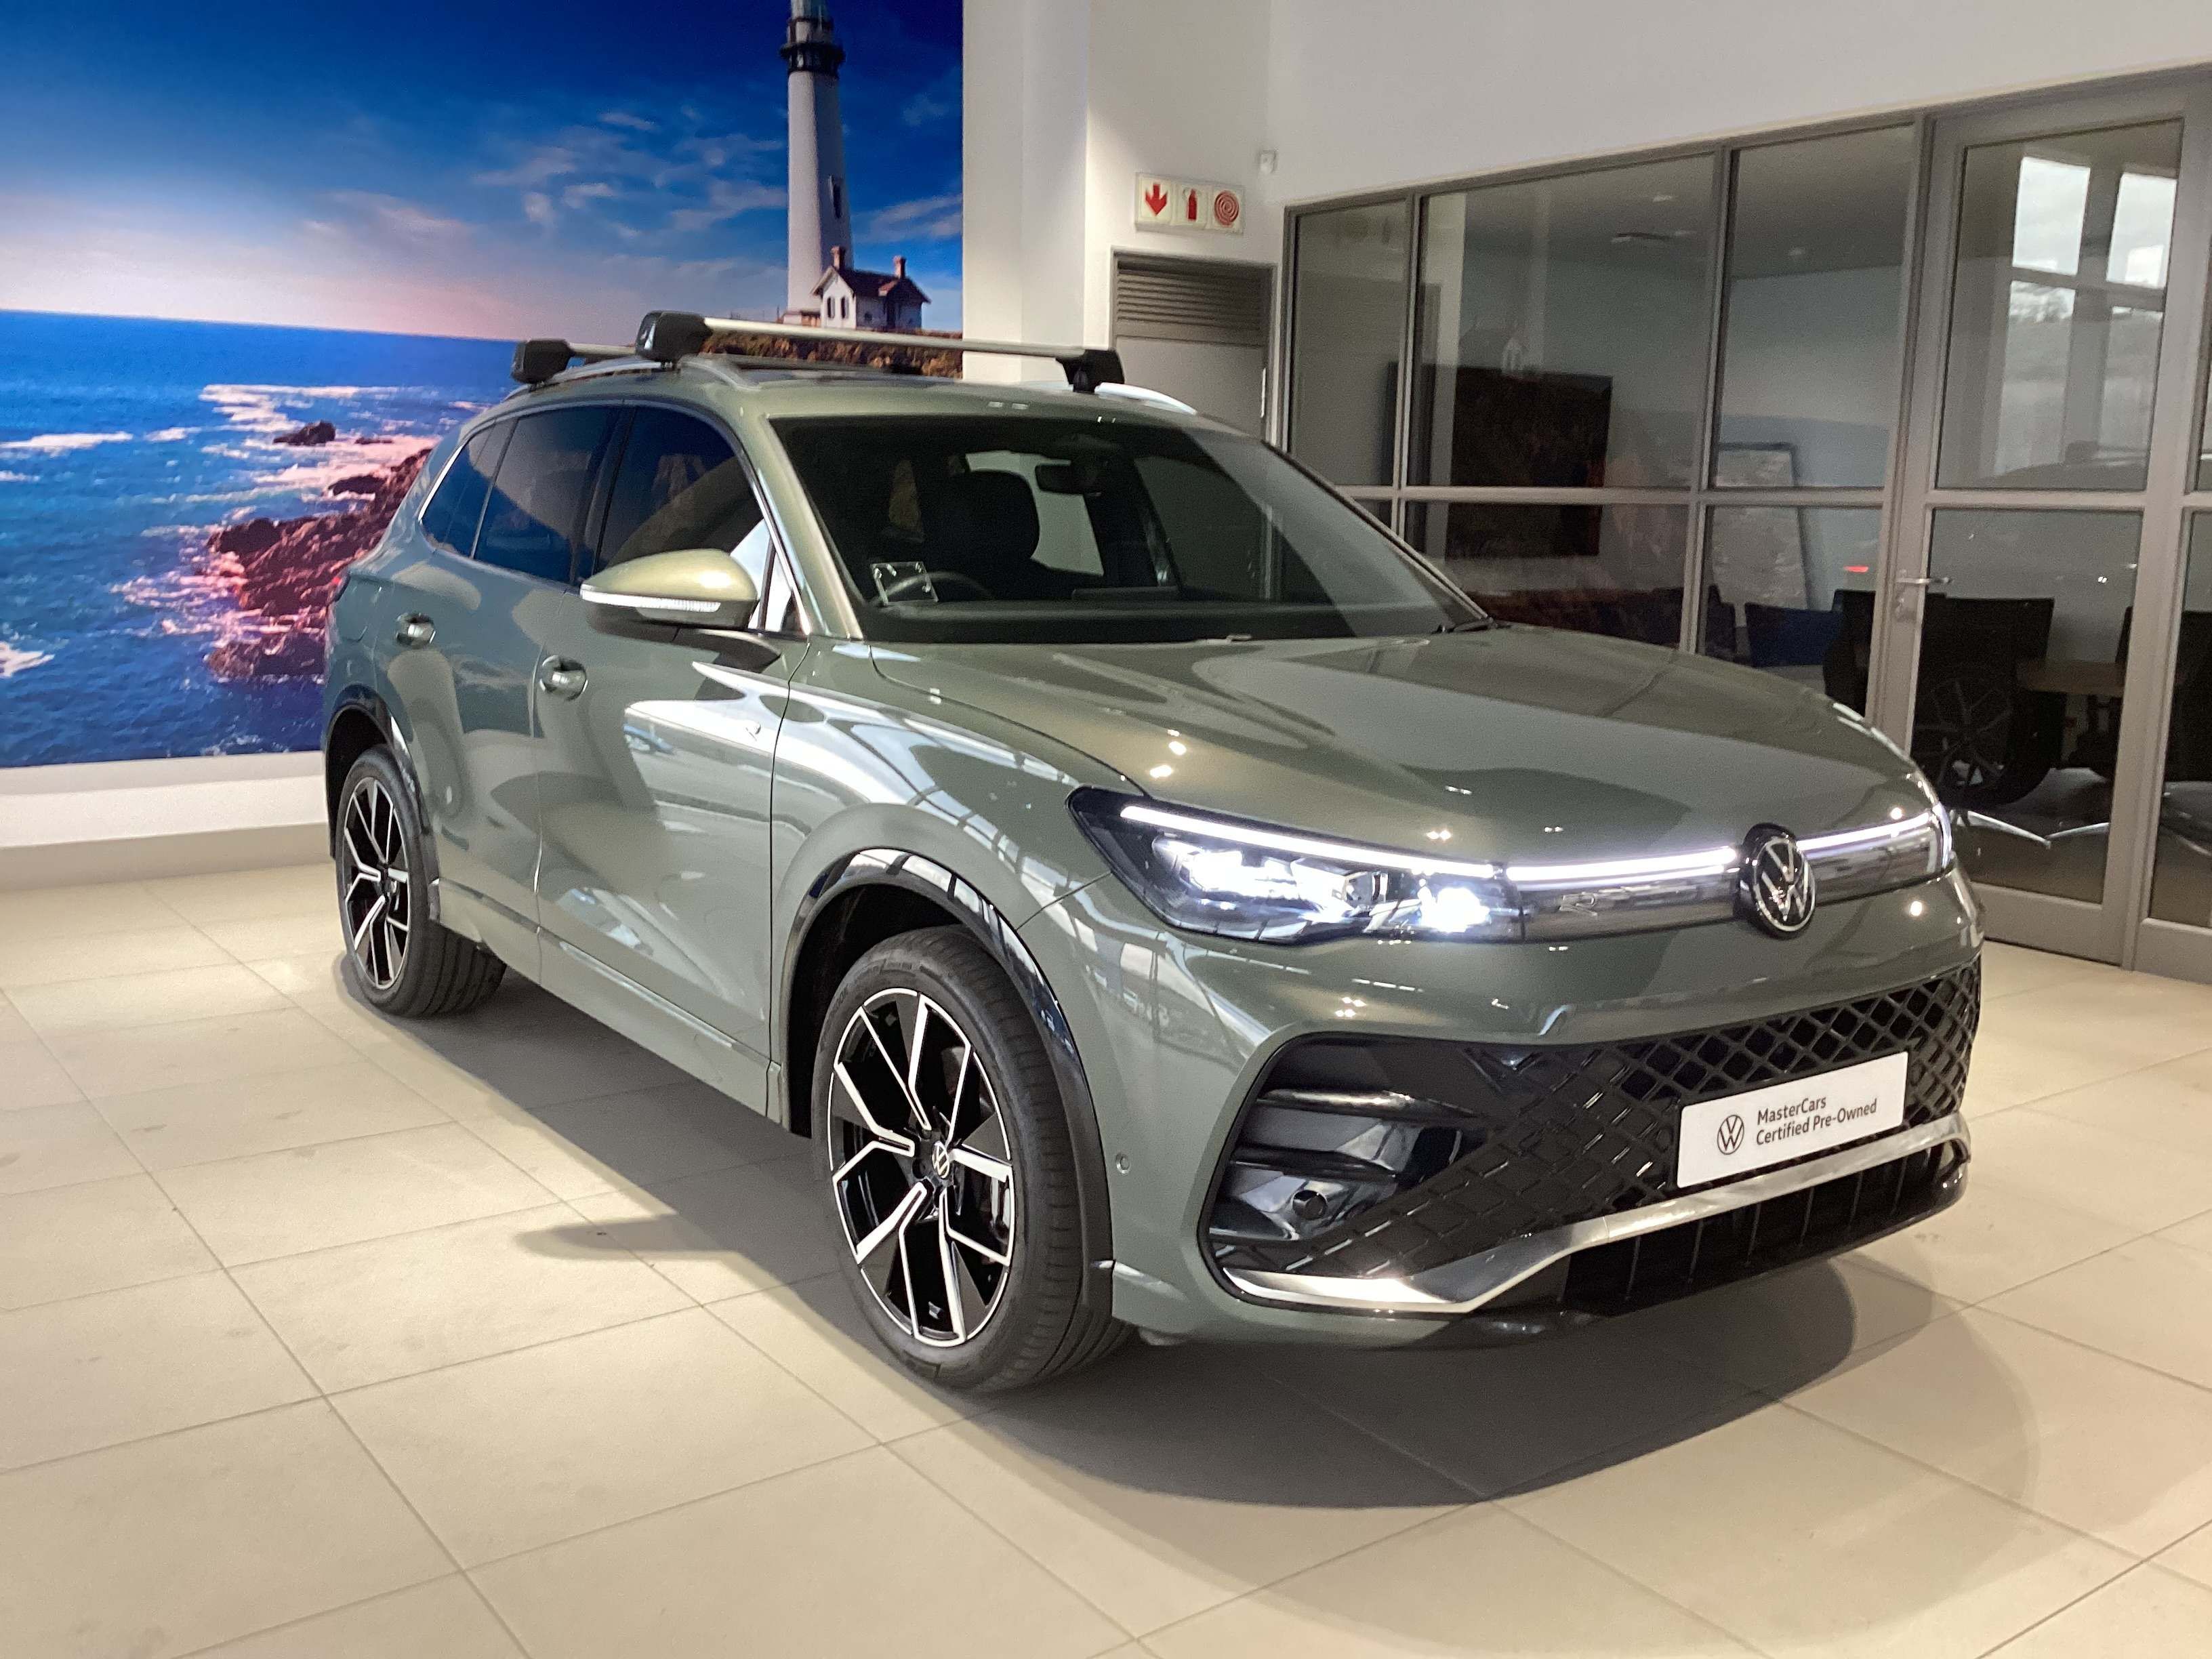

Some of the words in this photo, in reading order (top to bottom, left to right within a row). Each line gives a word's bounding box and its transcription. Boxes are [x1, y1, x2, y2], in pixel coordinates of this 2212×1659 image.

[1758, 840, 1813, 926] VW
[1756, 1116, 1811, 1145] Certified
[1813, 1098, 1877, 1130] Pre-Owned
[1757, 1097, 1827, 1126] MasterCars
[1717, 1115, 1744, 1153] VW
